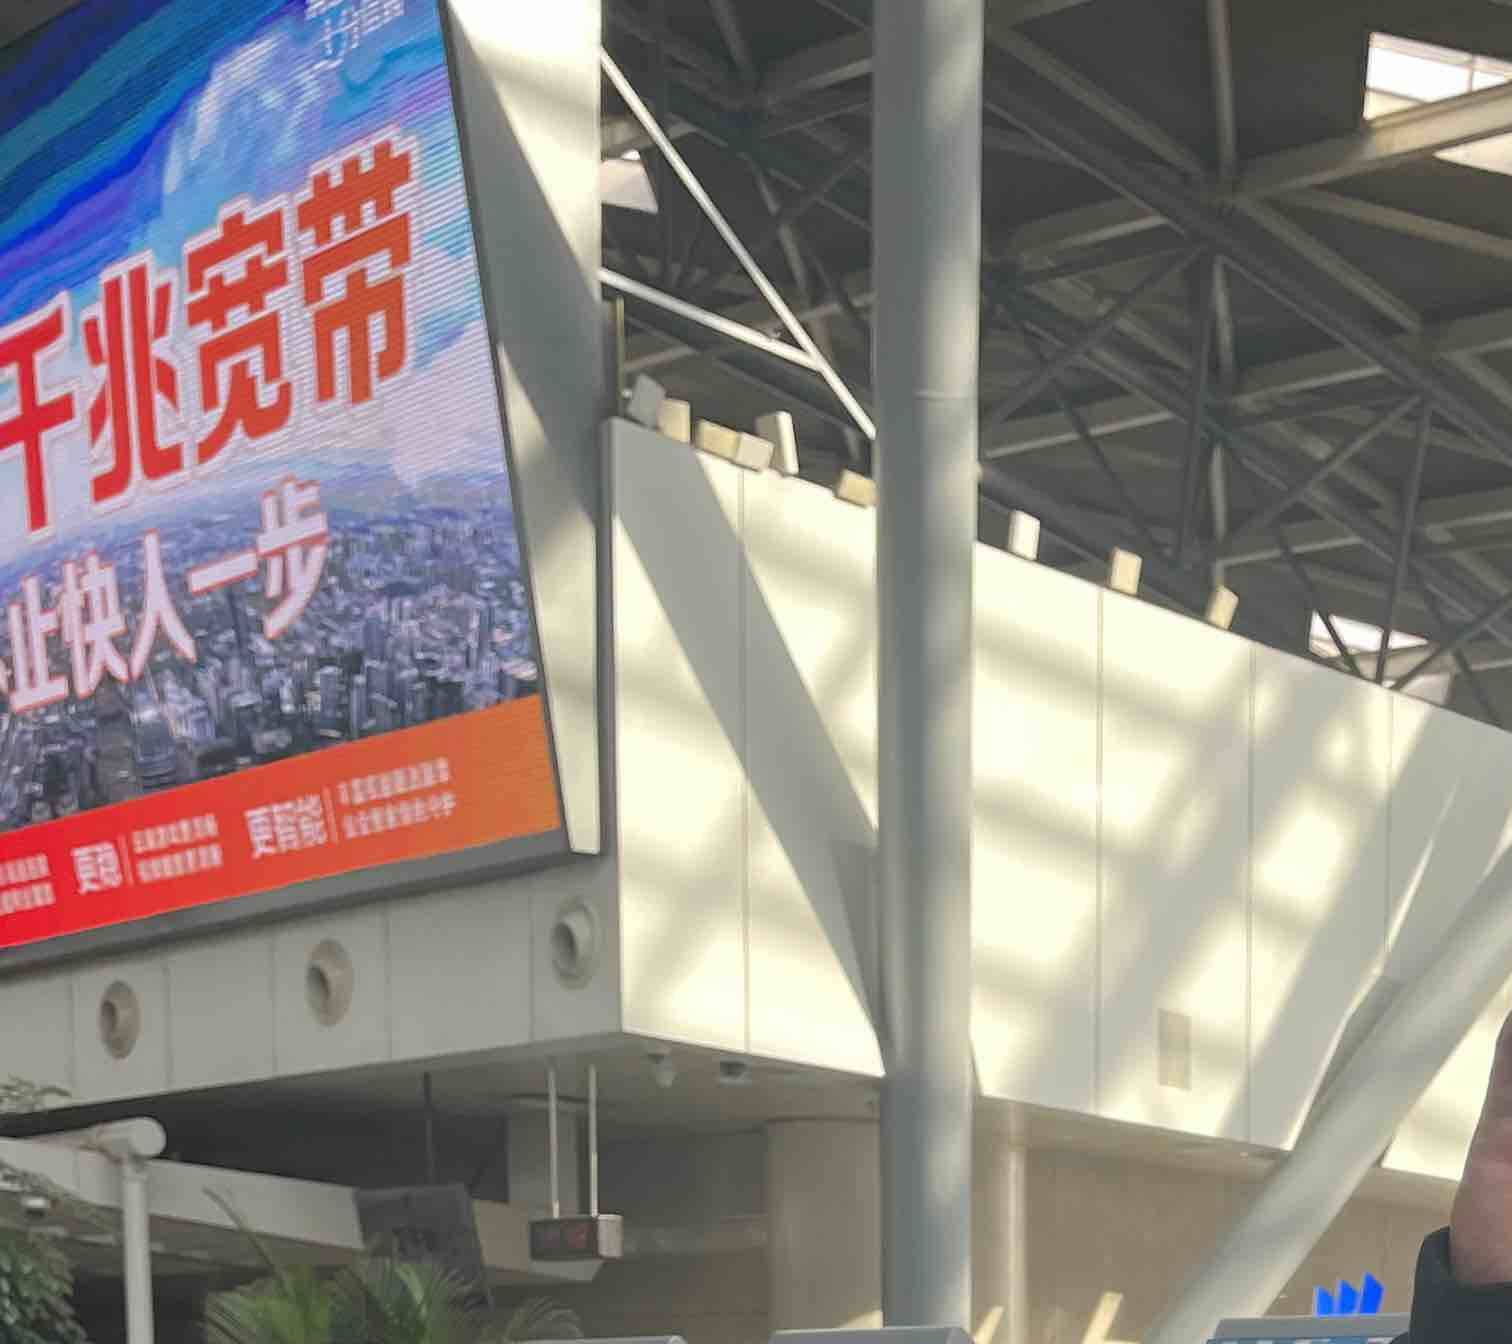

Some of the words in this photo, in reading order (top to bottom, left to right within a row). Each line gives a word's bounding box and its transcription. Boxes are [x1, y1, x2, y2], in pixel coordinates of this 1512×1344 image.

[0, 140, 412, 532] 千兆宽带
[0, 477, 328, 712] 止快人一步
